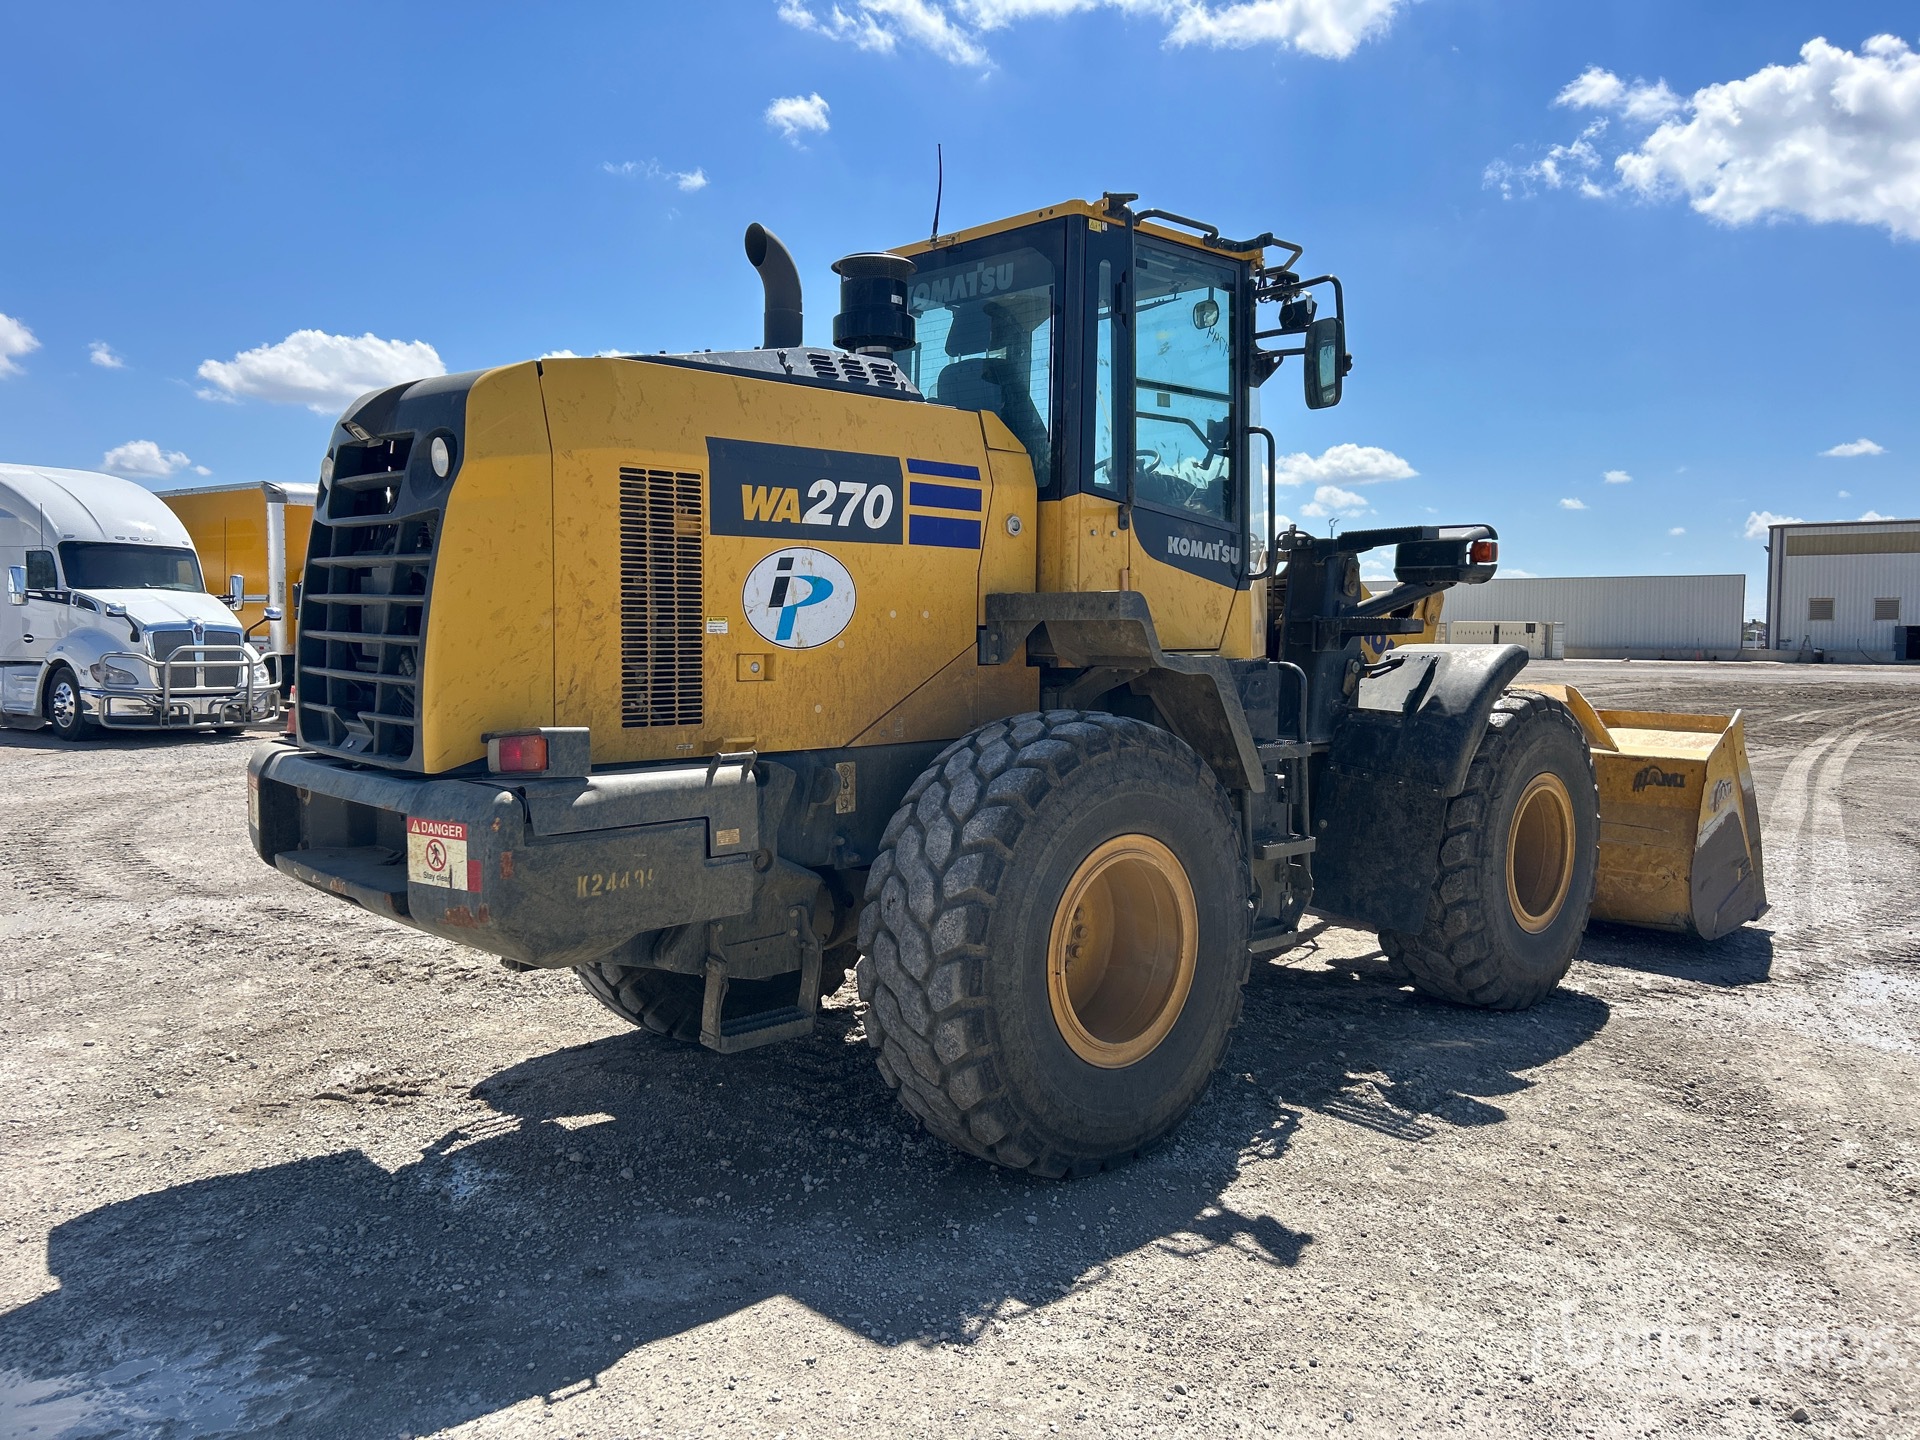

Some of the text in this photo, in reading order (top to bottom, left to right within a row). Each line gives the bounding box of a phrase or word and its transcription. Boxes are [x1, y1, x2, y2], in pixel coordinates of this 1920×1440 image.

[741, 479, 894, 529] WA270
[1167, 535, 1240, 564] KOMATSU
[421, 821, 463, 838] DANGER
[423, 871, 436, 882] Stay
